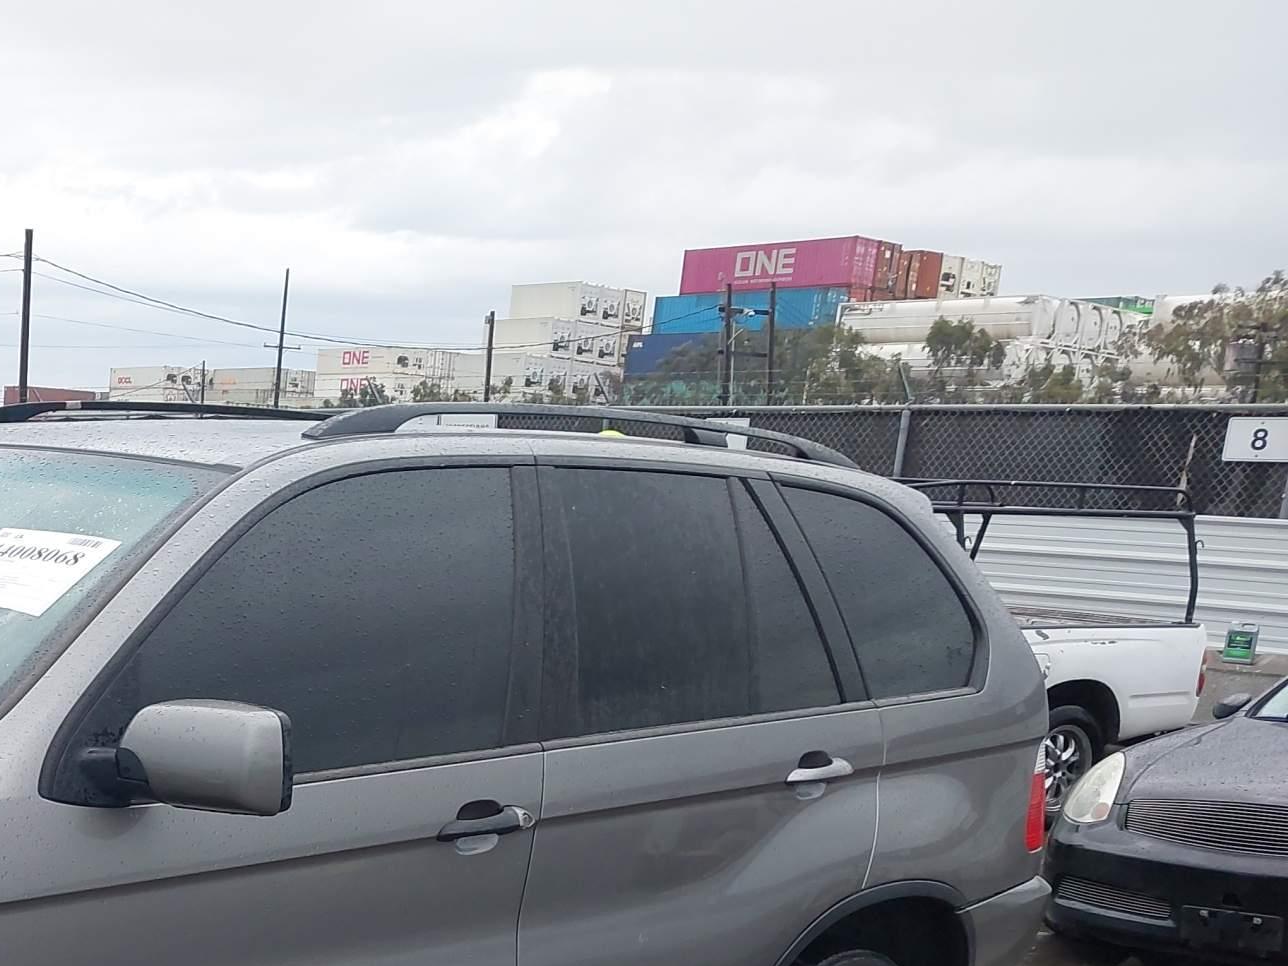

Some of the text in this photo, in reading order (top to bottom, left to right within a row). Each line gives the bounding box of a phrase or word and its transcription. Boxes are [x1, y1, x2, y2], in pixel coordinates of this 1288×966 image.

[734, 247, 797, 278] ONE
[342, 350, 369, 365] ONE
[1251, 428, 1268, 451] 8
